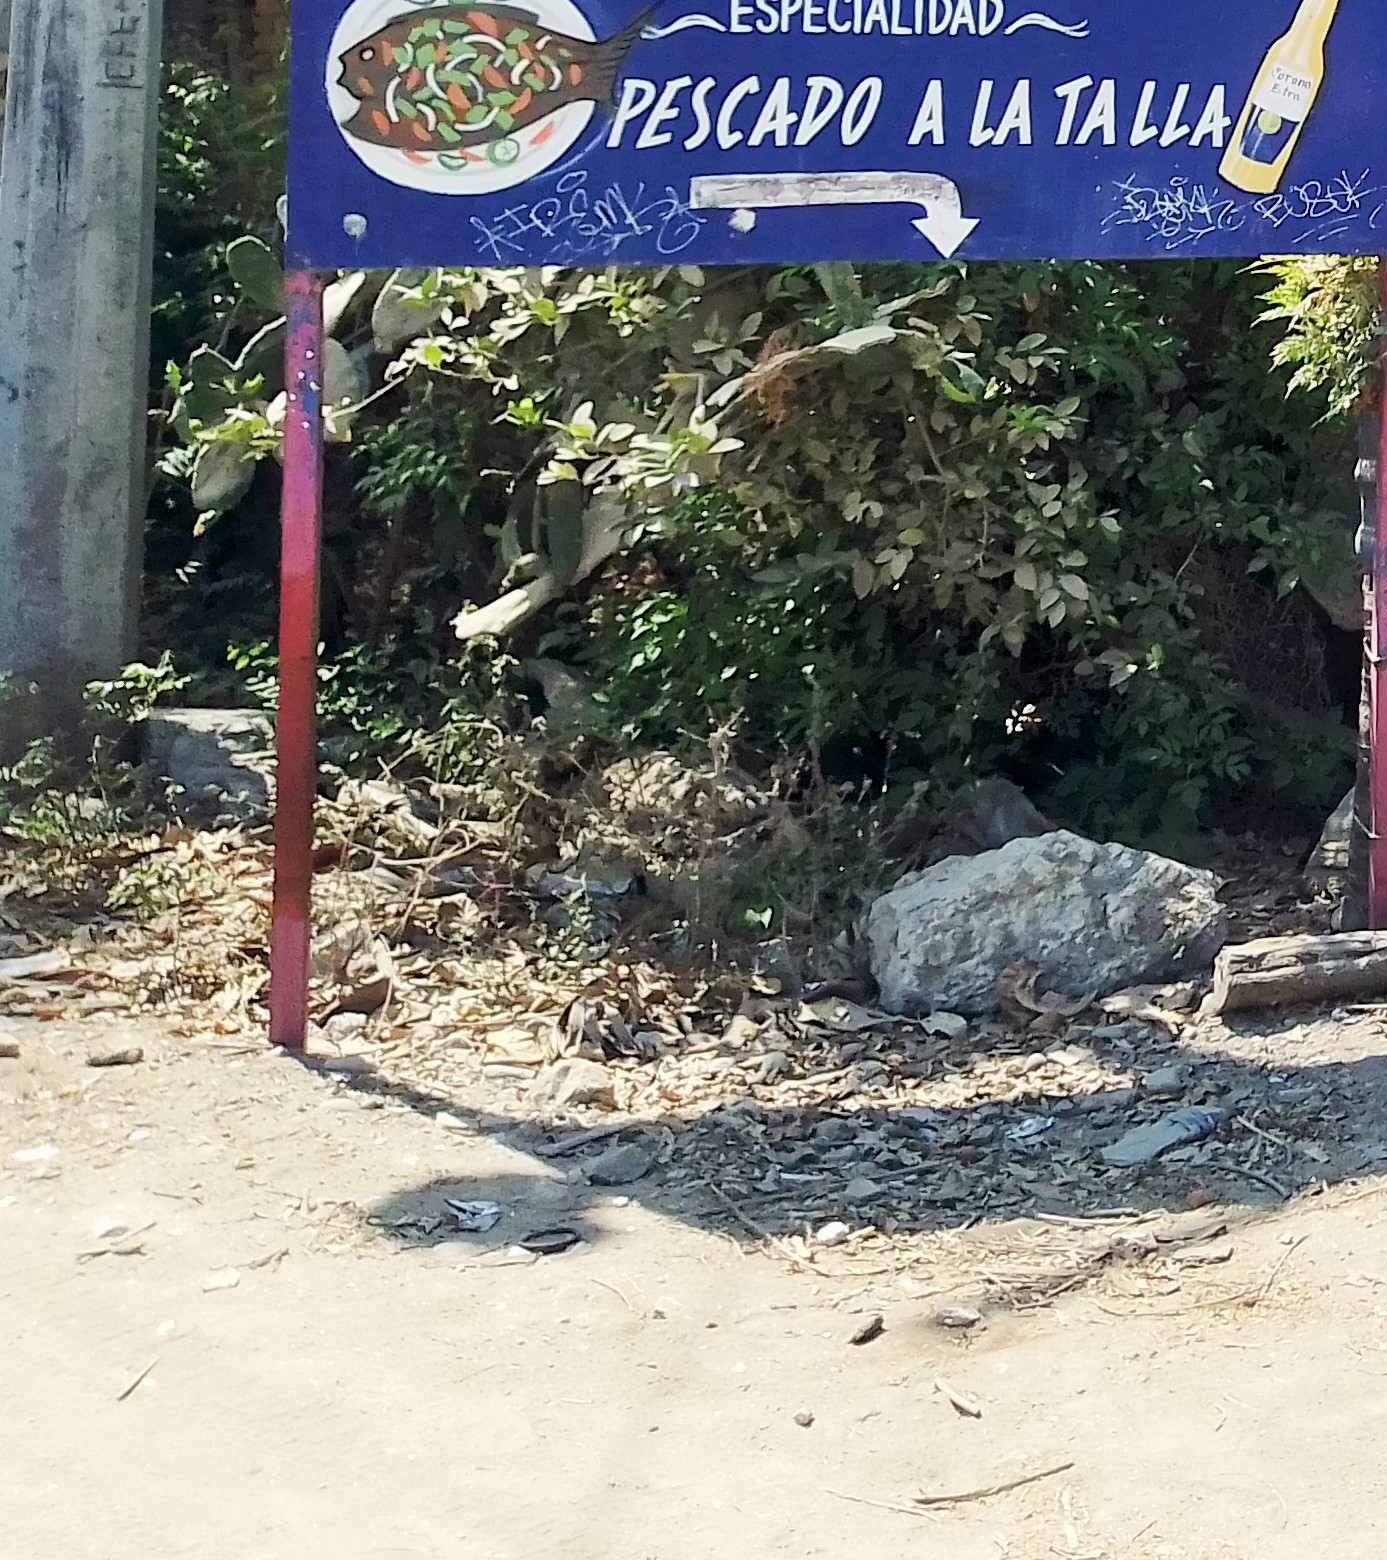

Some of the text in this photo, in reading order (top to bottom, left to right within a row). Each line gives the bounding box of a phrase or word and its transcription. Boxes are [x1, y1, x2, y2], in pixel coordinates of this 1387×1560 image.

[606, 74, 1232, 151] PESCADO A LA TALLA
